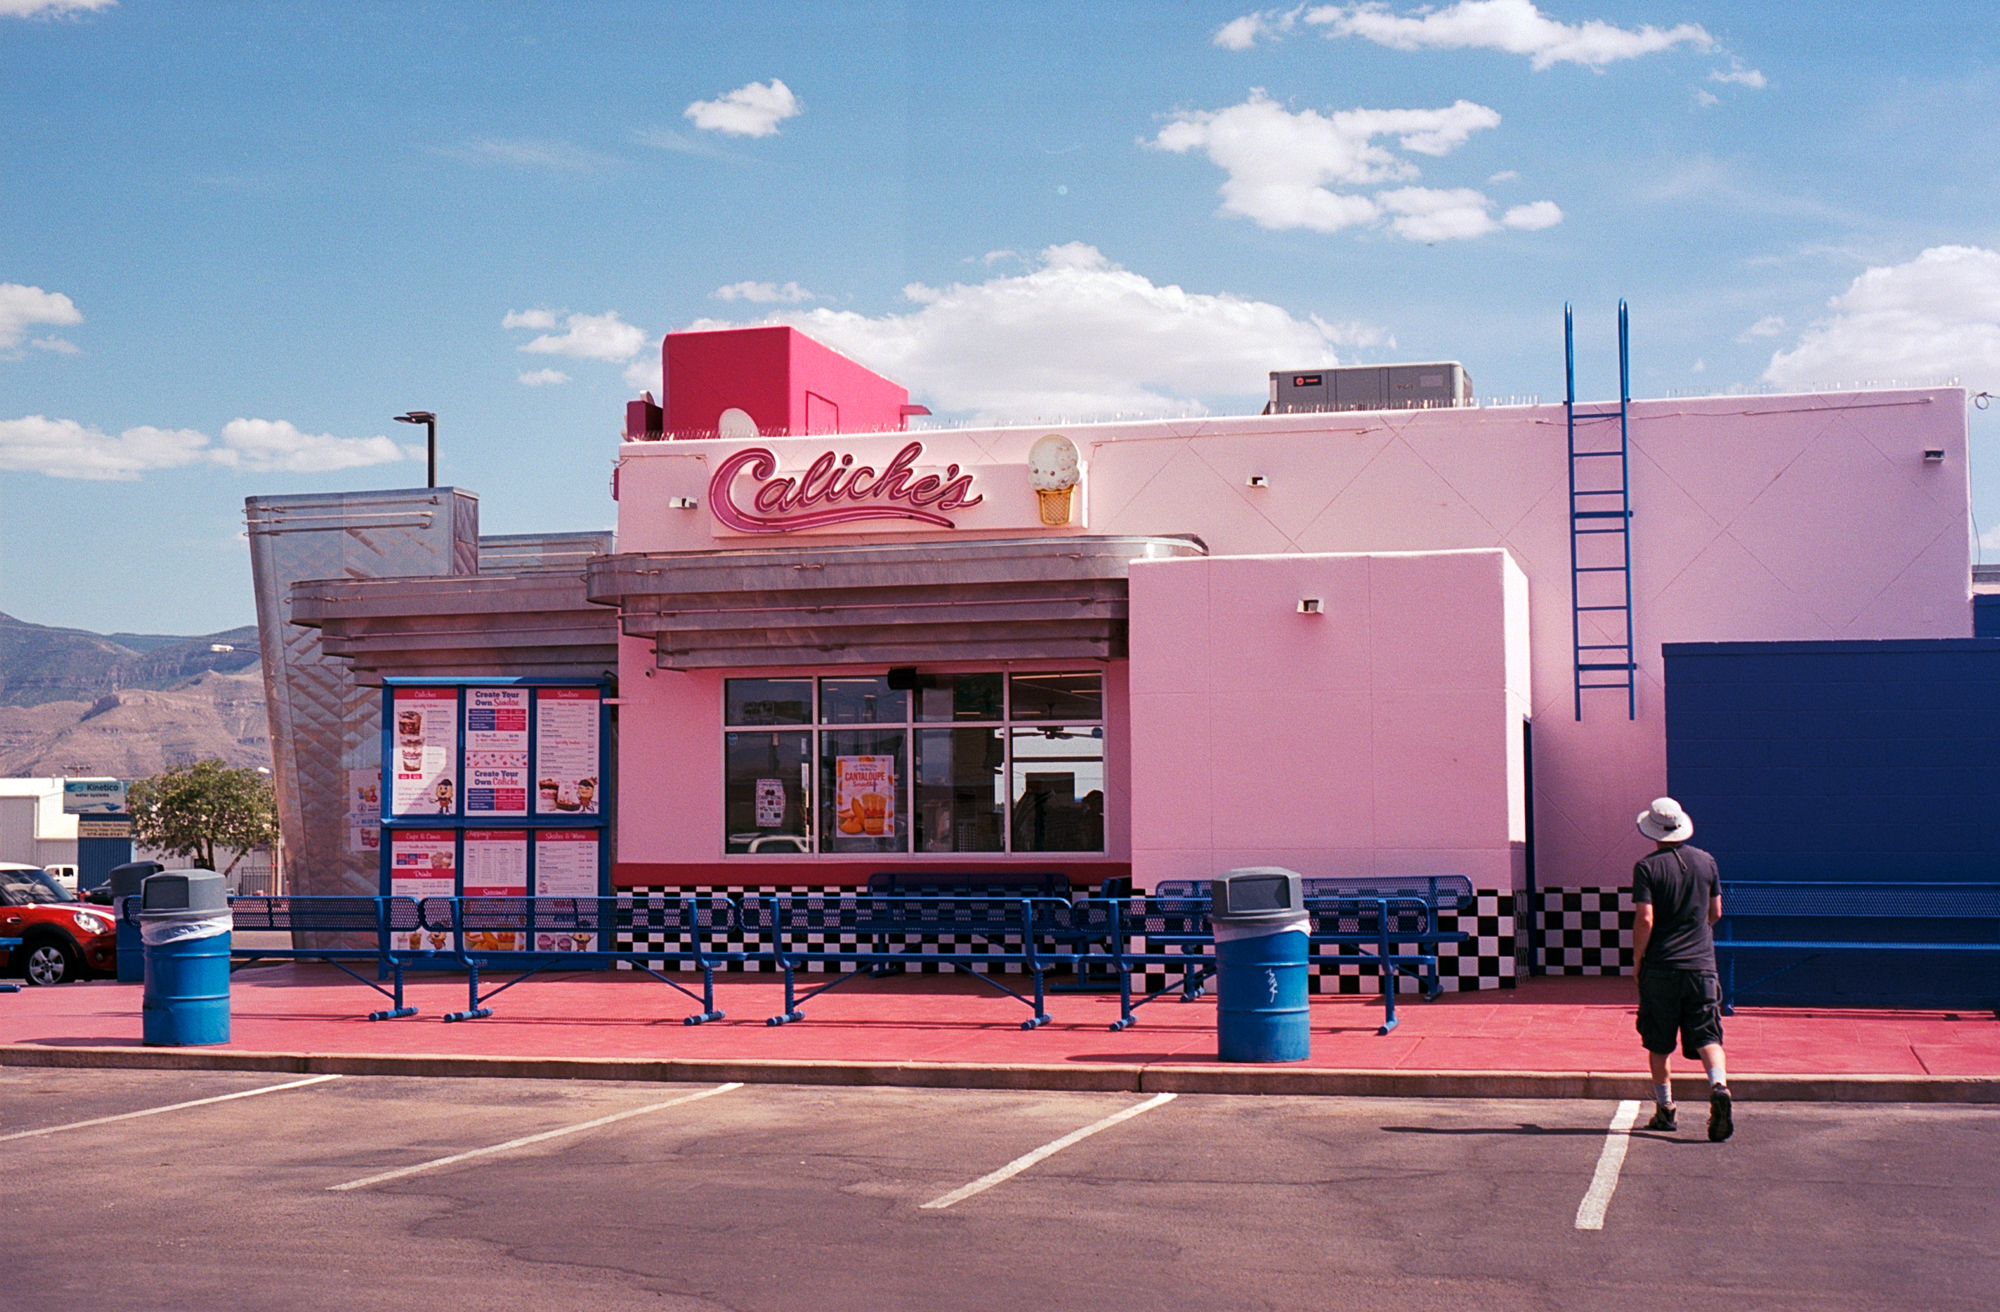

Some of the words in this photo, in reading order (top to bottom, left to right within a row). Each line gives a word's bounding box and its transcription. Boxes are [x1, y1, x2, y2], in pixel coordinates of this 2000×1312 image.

[709, 441, 983, 533] Caliche's
[475, 690, 500, 698] Create
[501, 690, 519, 698] Your
[493, 697, 519, 707] Sundae
[474, 769, 500, 777] Create
[501, 769, 519, 777] Your
[845, 771, 886, 781] CANTALOUPE
[492, 776, 518, 785] Caliche
[406, 832, 419, 840] Cups
[426, 832, 441, 840] Cones
[545, 832, 564, 840] Shakes
[565, 832, 570, 840] &
[570, 832, 586, 840] More
[482, 888, 508, 896] Seasonal
